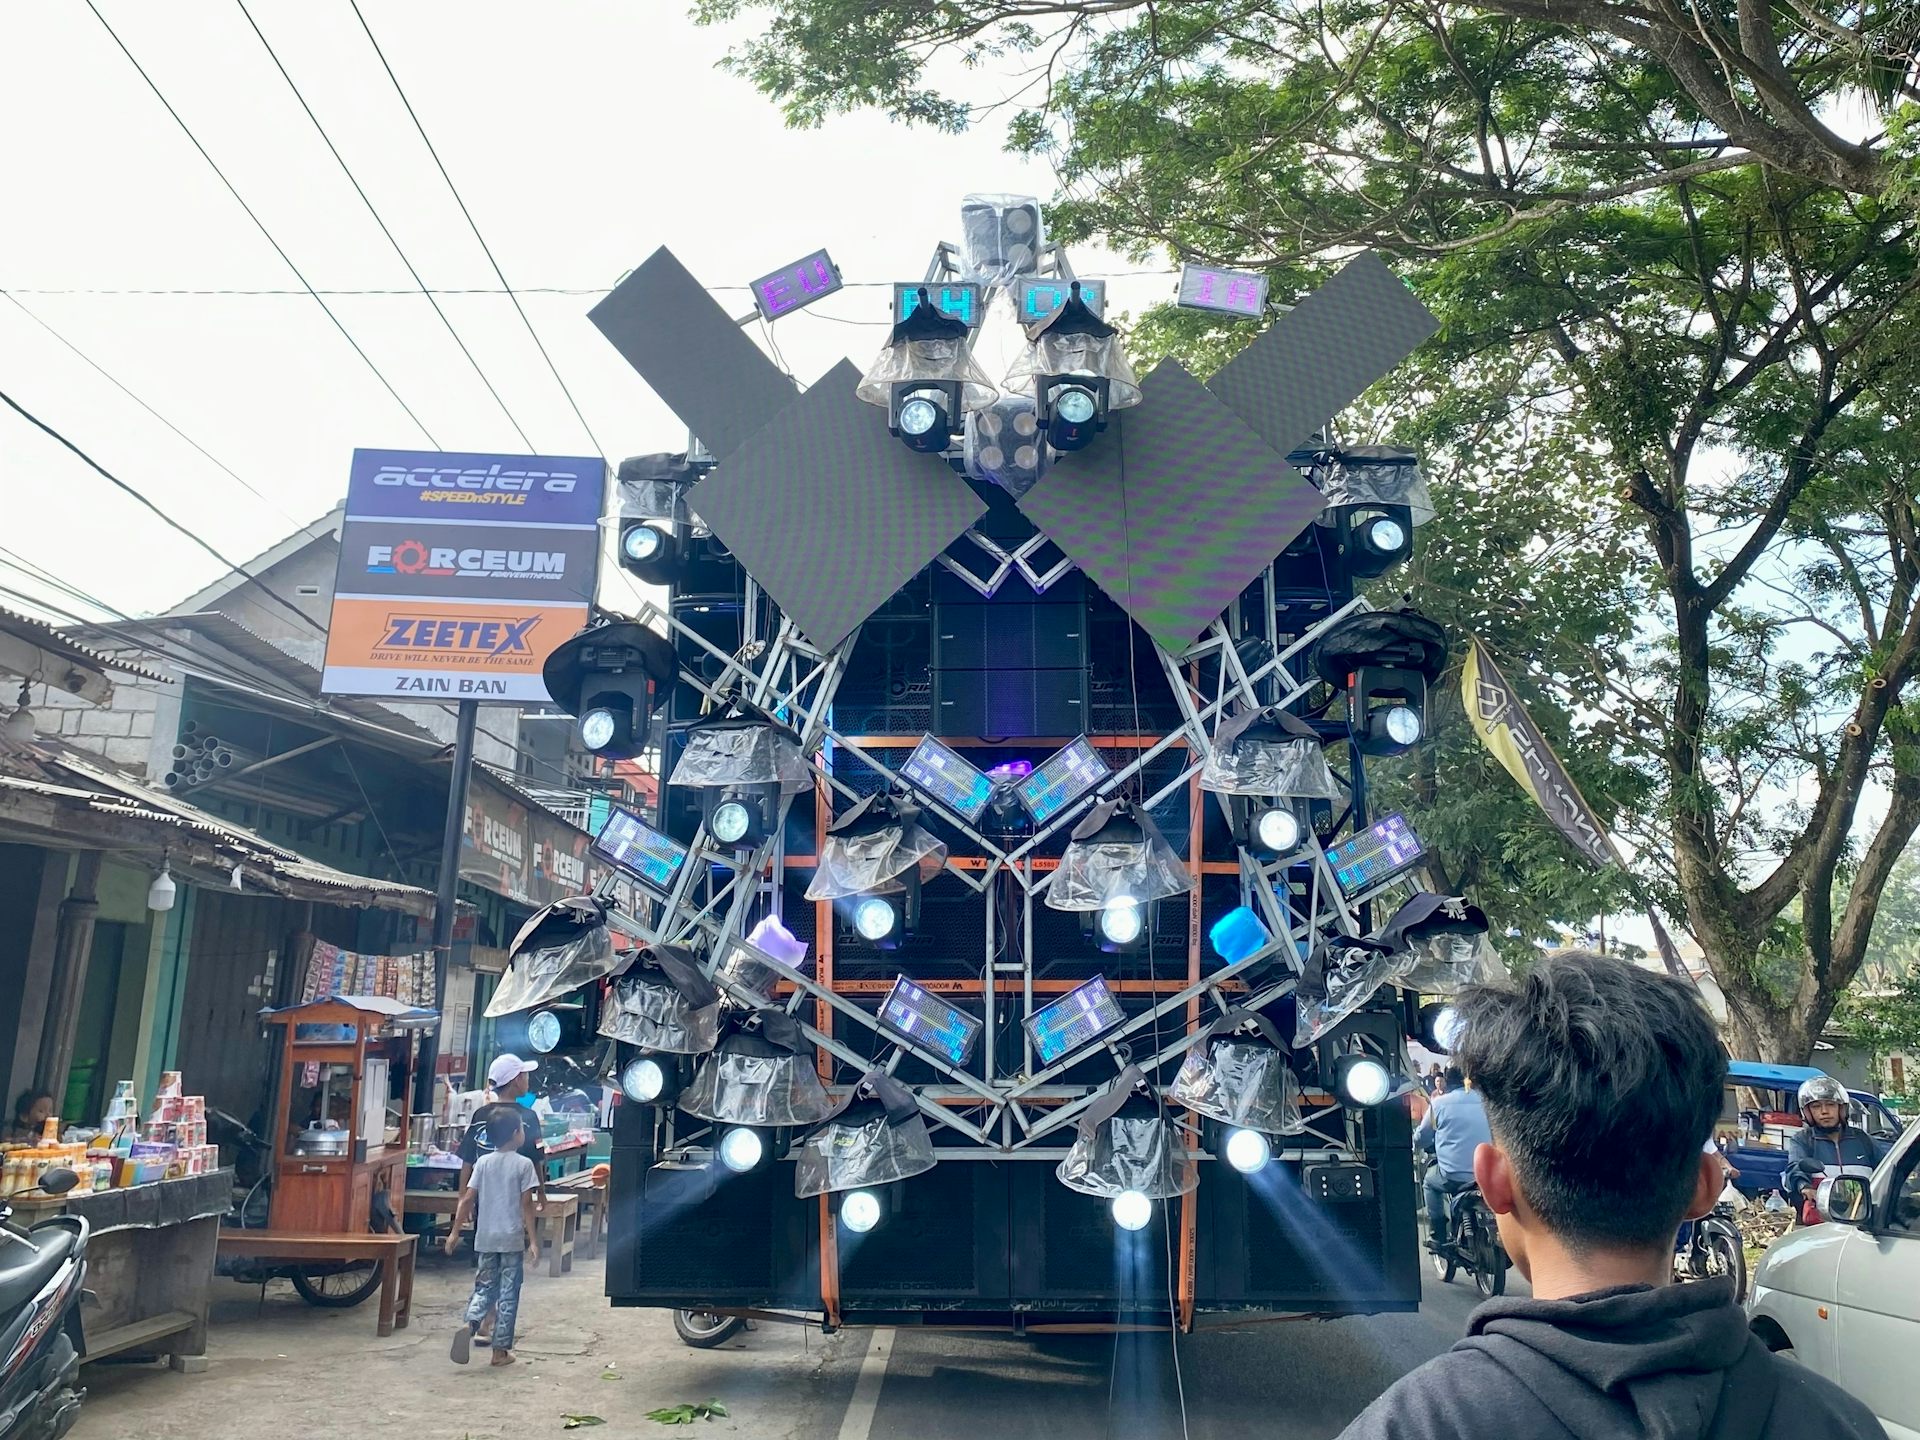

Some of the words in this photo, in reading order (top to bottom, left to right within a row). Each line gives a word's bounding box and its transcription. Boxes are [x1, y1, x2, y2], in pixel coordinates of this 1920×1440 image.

[762, 259, 829, 313] EU
[1194, 272, 1257, 309] IA
[373, 464, 578, 493] accelera
[367, 539, 566, 575] FORCEUM
[384, 613, 543, 659] ZEETEX
[369, 652, 402, 662] DRIVE
[404, 653, 429, 662] WILL
[431, 654, 467, 664] NEVER
[468, 656, 482, 664] BE
[483, 656, 505, 665] THE
[506, 657, 535, 666] SAME
[395, 676, 451, 692] ZAIN
[458, 679, 507, 694] BAN
[464, 803, 522, 861] FORCEUM
[533, 839, 584, 885] FORCEUM
